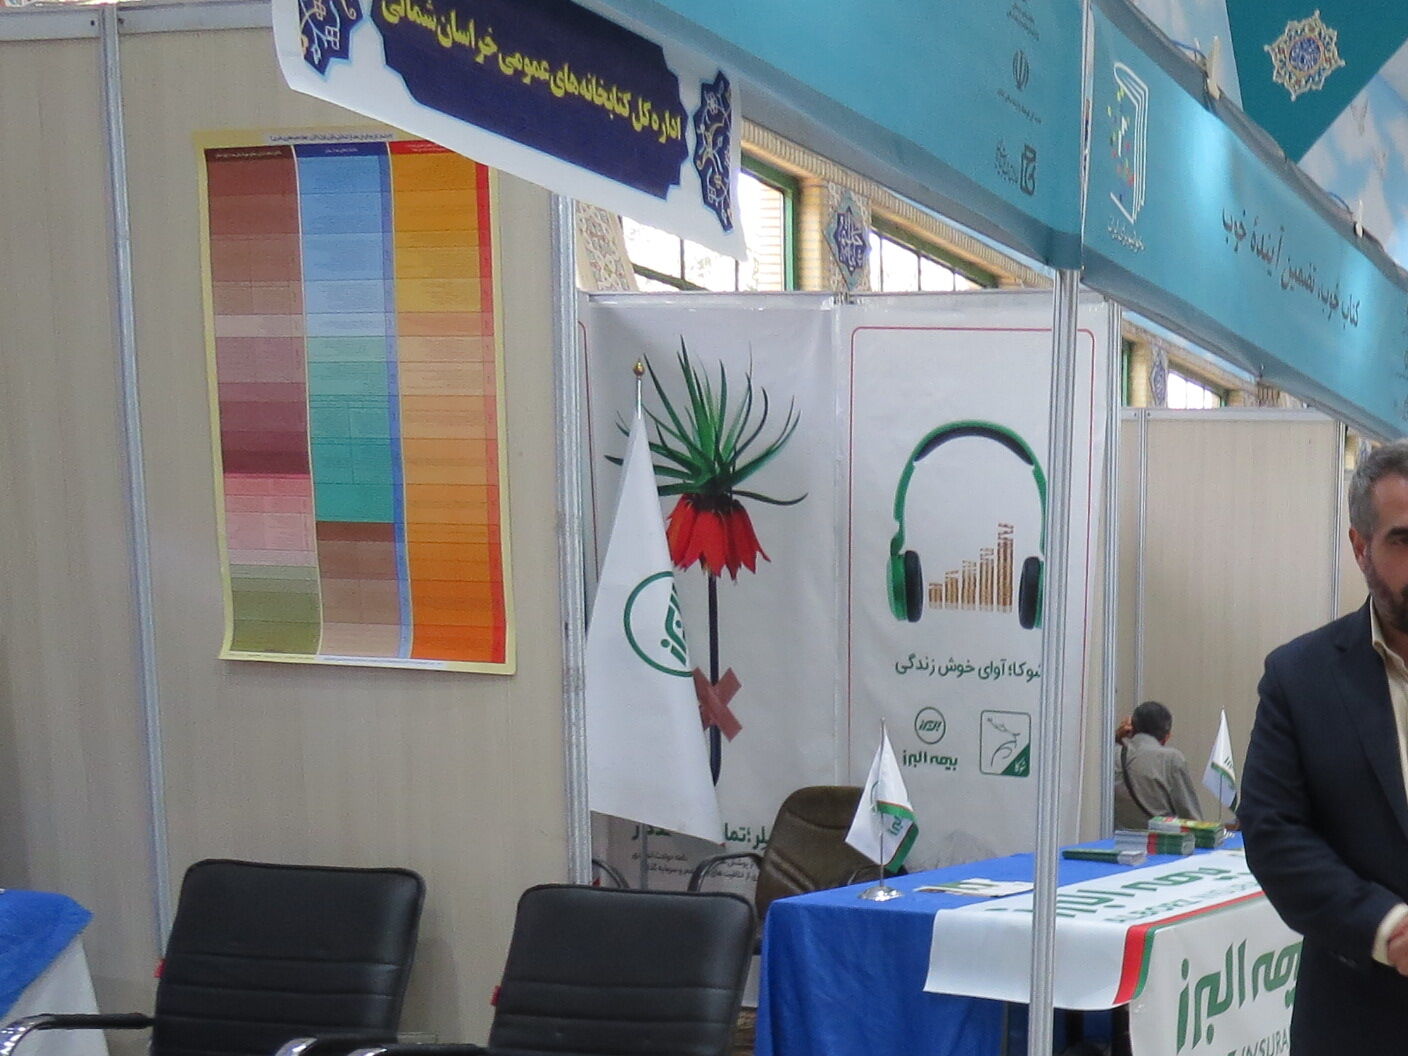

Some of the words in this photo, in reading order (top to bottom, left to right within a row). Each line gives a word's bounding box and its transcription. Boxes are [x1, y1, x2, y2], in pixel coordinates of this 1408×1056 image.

[437, 10, 498, 63] خراسان
[499, 50, 551, 84] عمومی
[633, 97, 651, 131] کل
[1222, 207, 1247, 253] خوب
[1281, 256, 1317, 293] تضمین
[1341, 293, 1361, 330] کتاب
[895, 652, 936, 677] زندگی
[938, 657, 975, 679] خوش
[978, 658, 1006, 681] آوای
[902, 750, 927, 768] البرز
[930, 755, 958, 771] بیمه
[1176, 938, 1248, 1056] البرز
